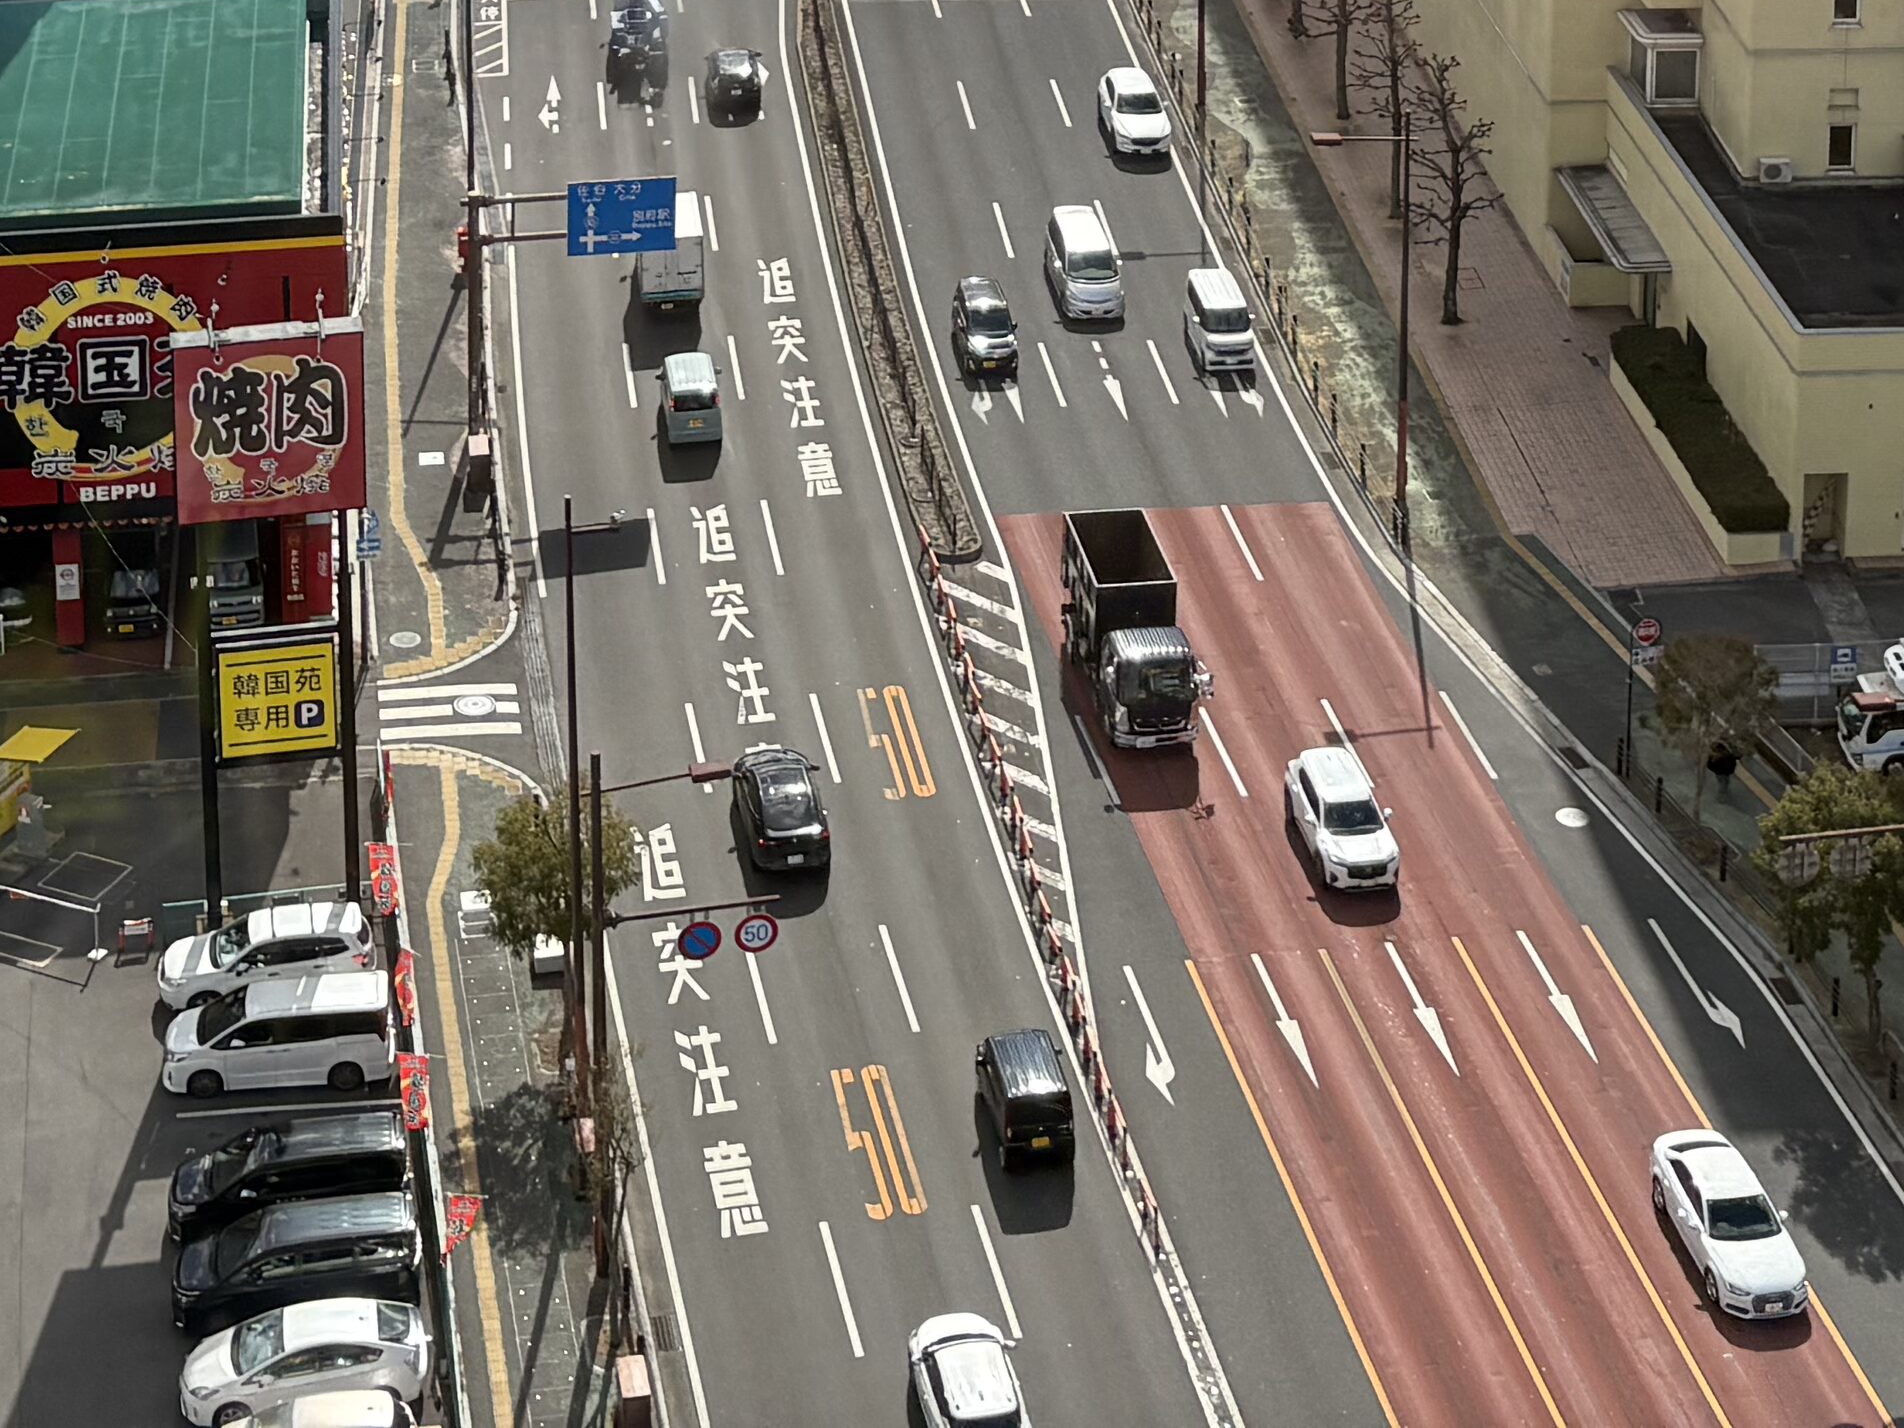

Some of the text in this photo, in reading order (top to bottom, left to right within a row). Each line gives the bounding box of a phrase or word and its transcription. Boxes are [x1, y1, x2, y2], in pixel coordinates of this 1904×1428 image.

[66, 312, 155, 329] SINCE 2003
[189, 354, 348, 462] 焼肉
[756, 256, 843, 498] 追突注意
[79, 481, 157, 503] BEPPU
[692, 504, 778, 752] 追突注
[232, 666, 322, 699] 韓国苑
[743, 923, 770, 944] 50
[631, 823, 769, 1238] 追突注意
[830, 1063, 929, 1221] 50
